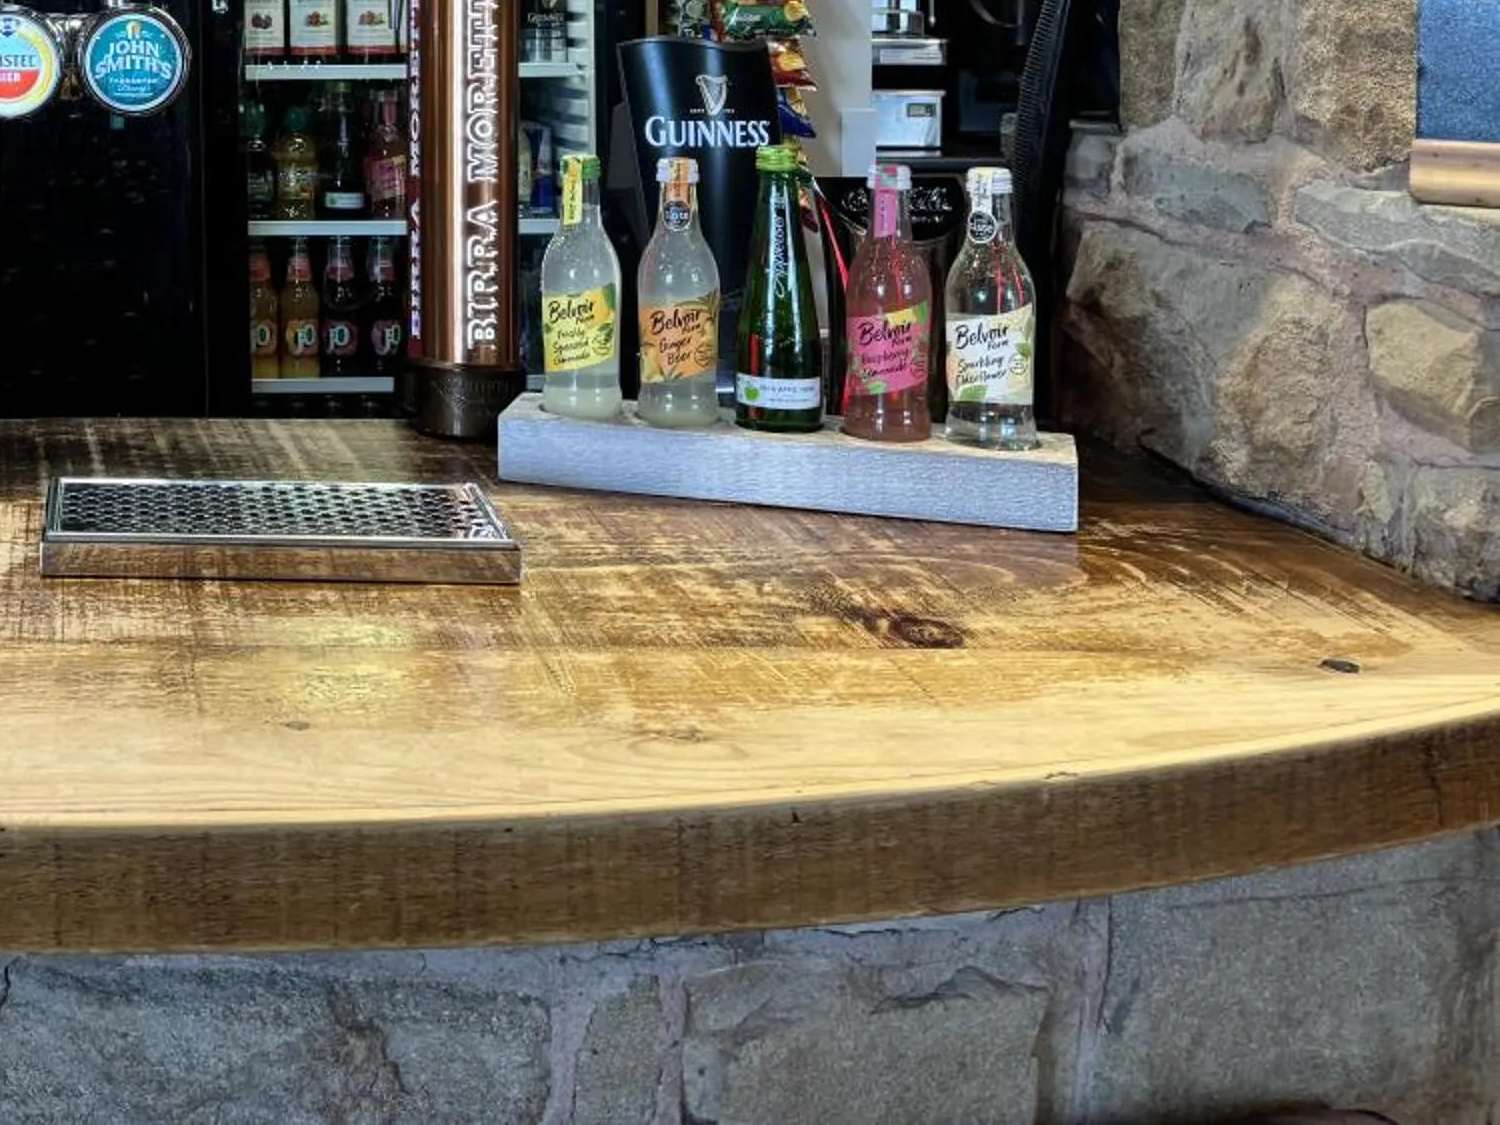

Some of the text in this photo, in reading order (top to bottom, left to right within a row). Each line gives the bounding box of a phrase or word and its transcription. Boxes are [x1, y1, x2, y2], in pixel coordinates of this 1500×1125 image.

[108, 39, 160, 57] JOHN
[95, 53, 173, 80] SMITH'S
[644, 115, 770, 148] GUINNESS
[467, 198, 499, 351] BIRRA
[548, 298, 596, 325] Belvoir
[650, 309, 701, 335] Belvoir
[659, 336, 693, 354] Ginger
[857, 318, 911, 346] Belvoir
[955, 322, 1009, 350] Belvoir
[667, 350, 692, 366] Beer
